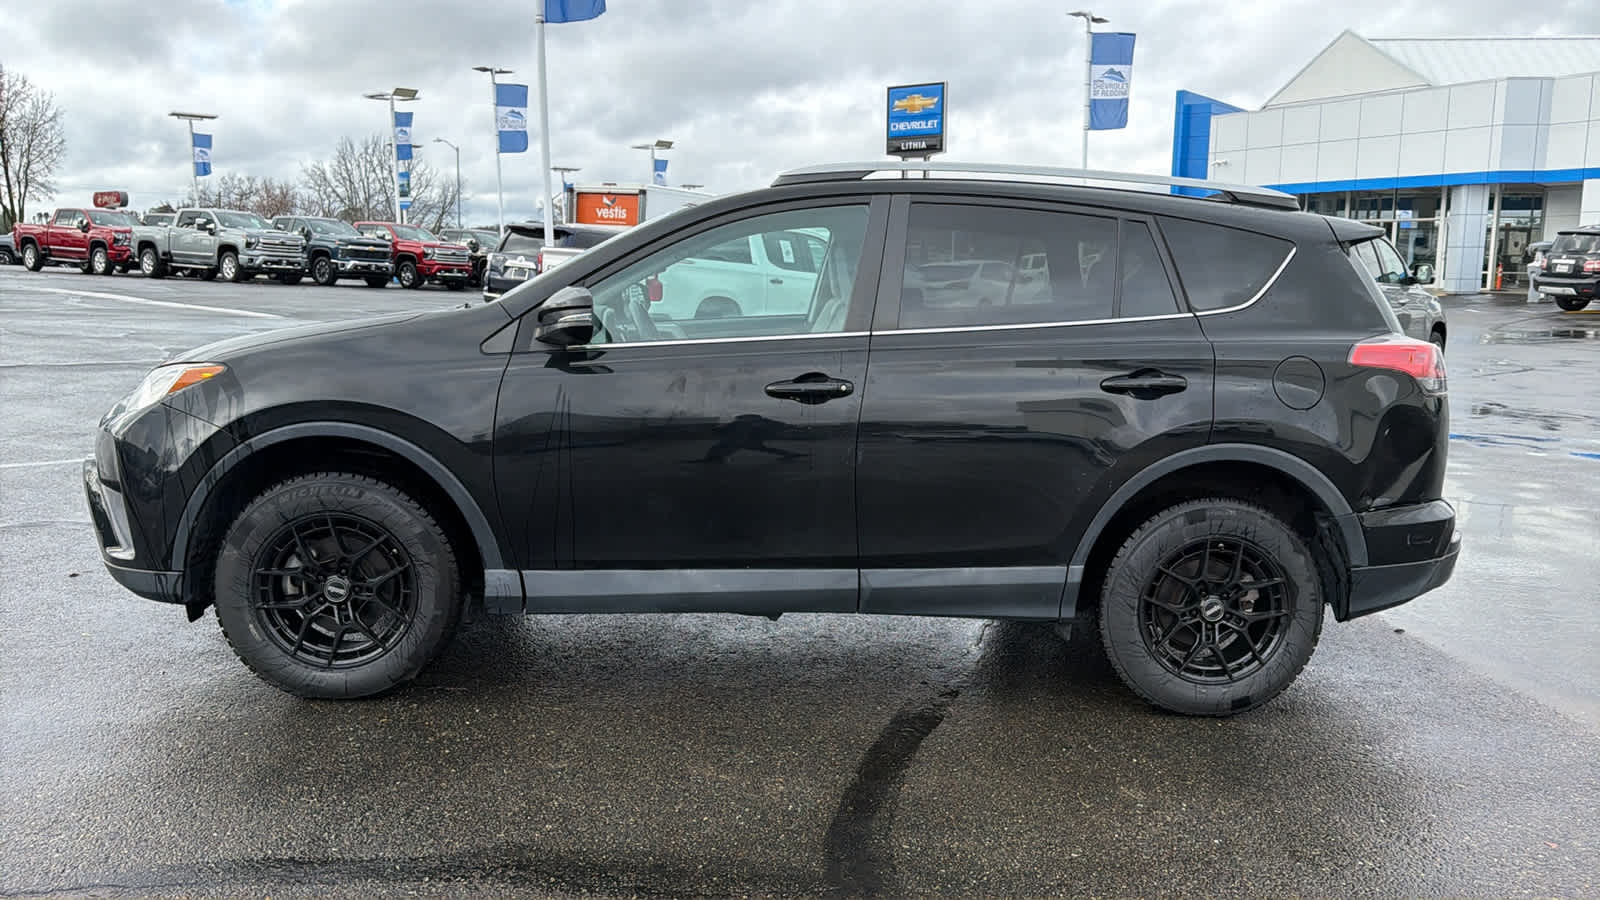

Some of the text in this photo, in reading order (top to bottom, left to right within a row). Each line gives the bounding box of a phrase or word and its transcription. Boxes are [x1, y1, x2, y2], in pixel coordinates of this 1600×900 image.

[890, 120, 938, 131] CHEVROLET
[901, 141, 927, 151] LITHIA
[595, 206, 627, 219] vestis
